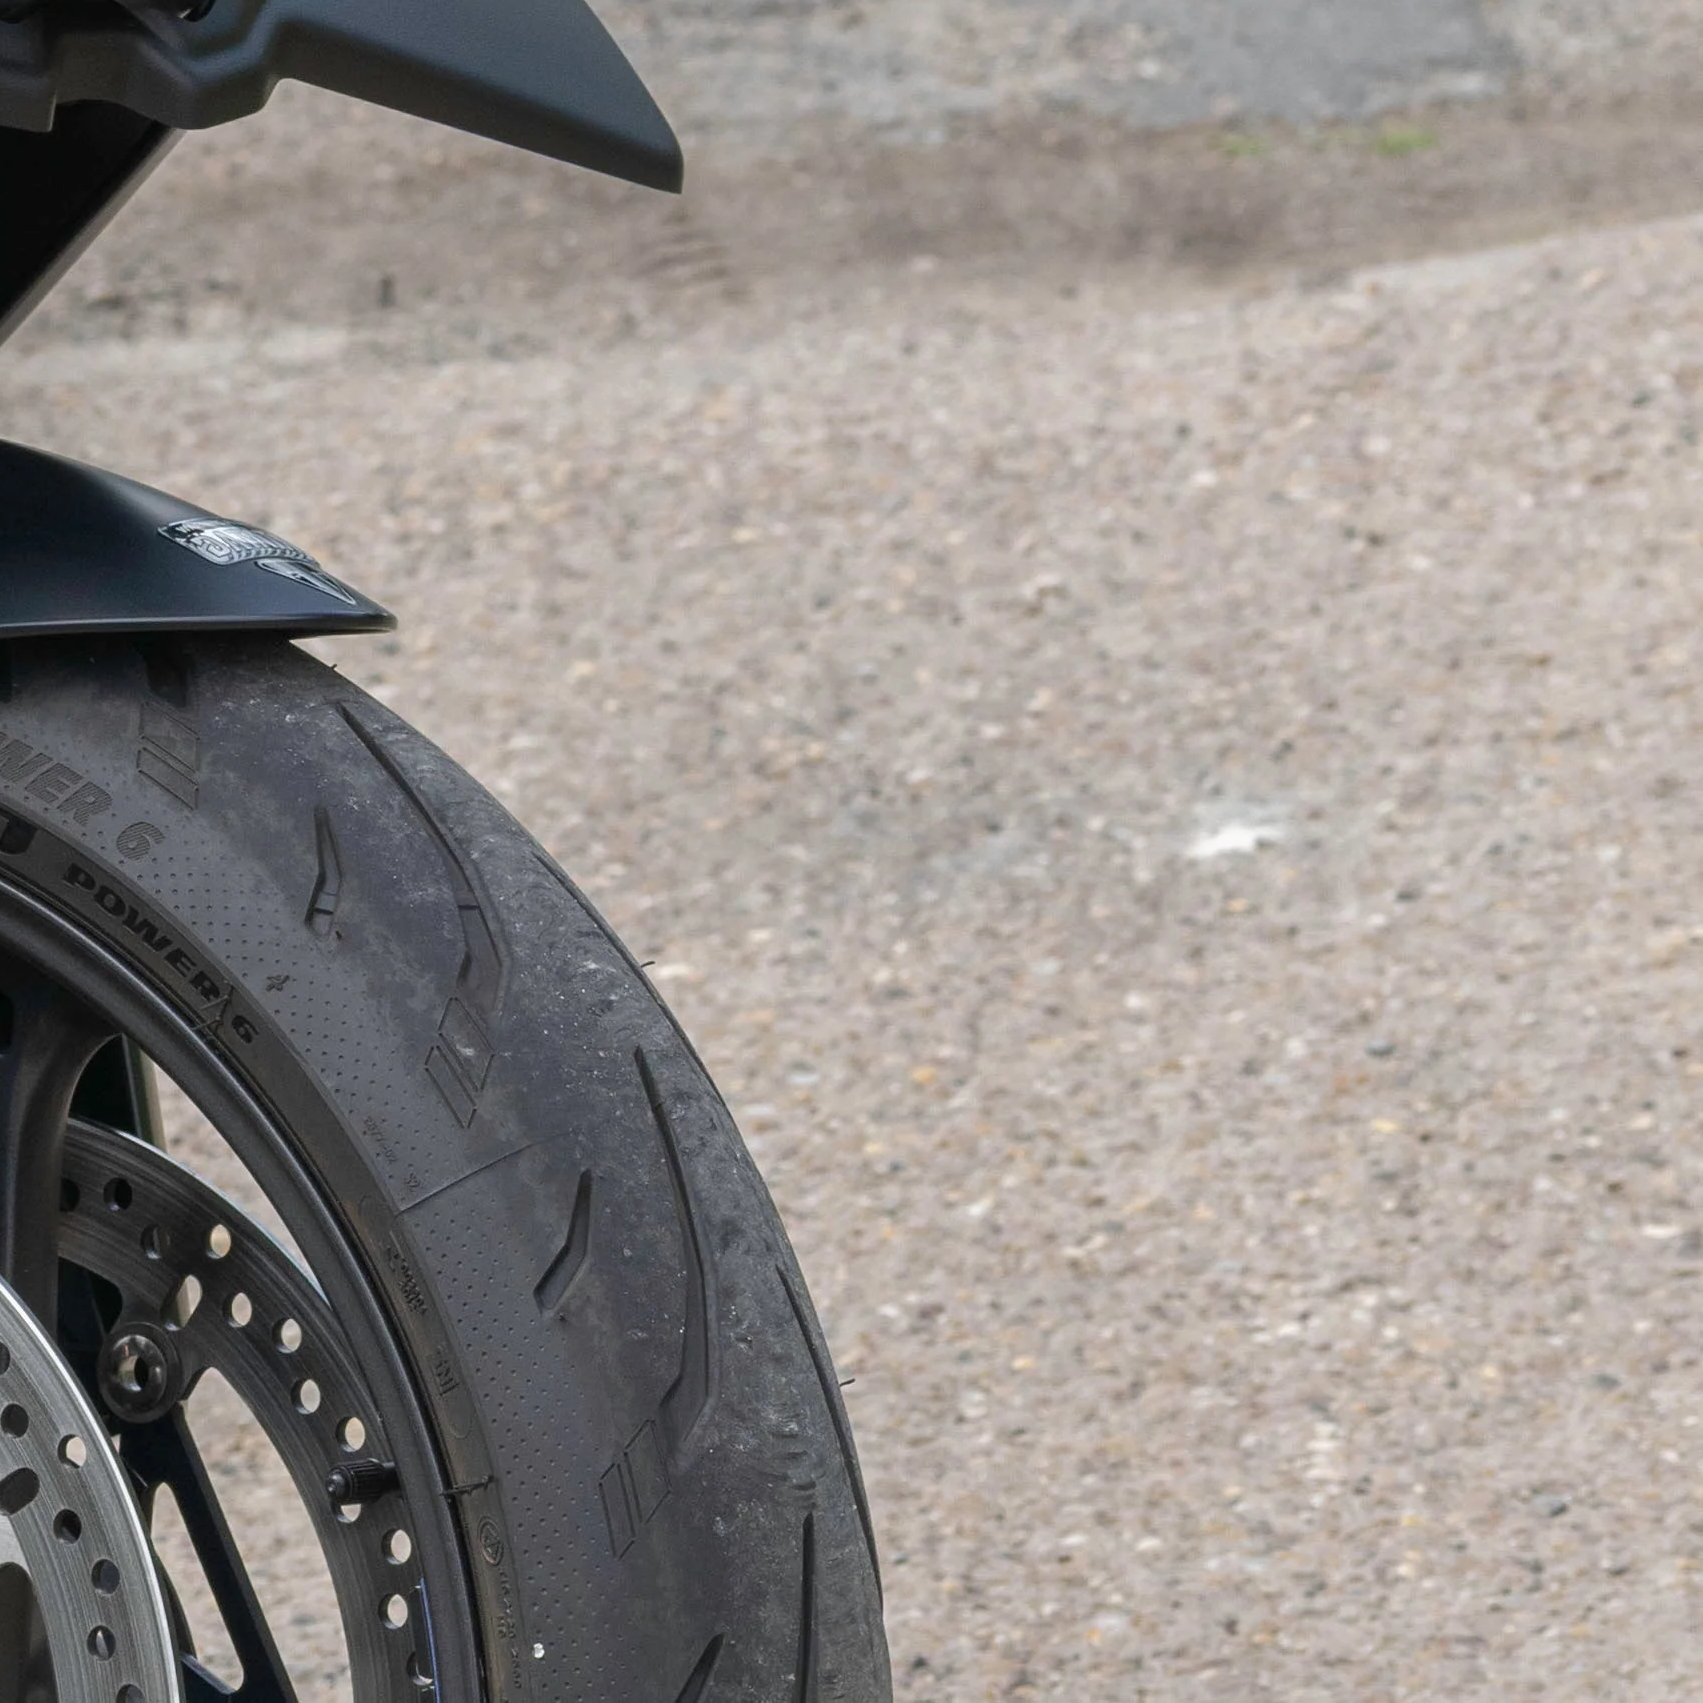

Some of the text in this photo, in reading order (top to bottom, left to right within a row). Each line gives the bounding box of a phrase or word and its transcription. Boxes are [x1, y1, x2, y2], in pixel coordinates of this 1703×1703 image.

[116, 821, 165, 861] 6
[61, 862, 261, 1045] POWER 6
